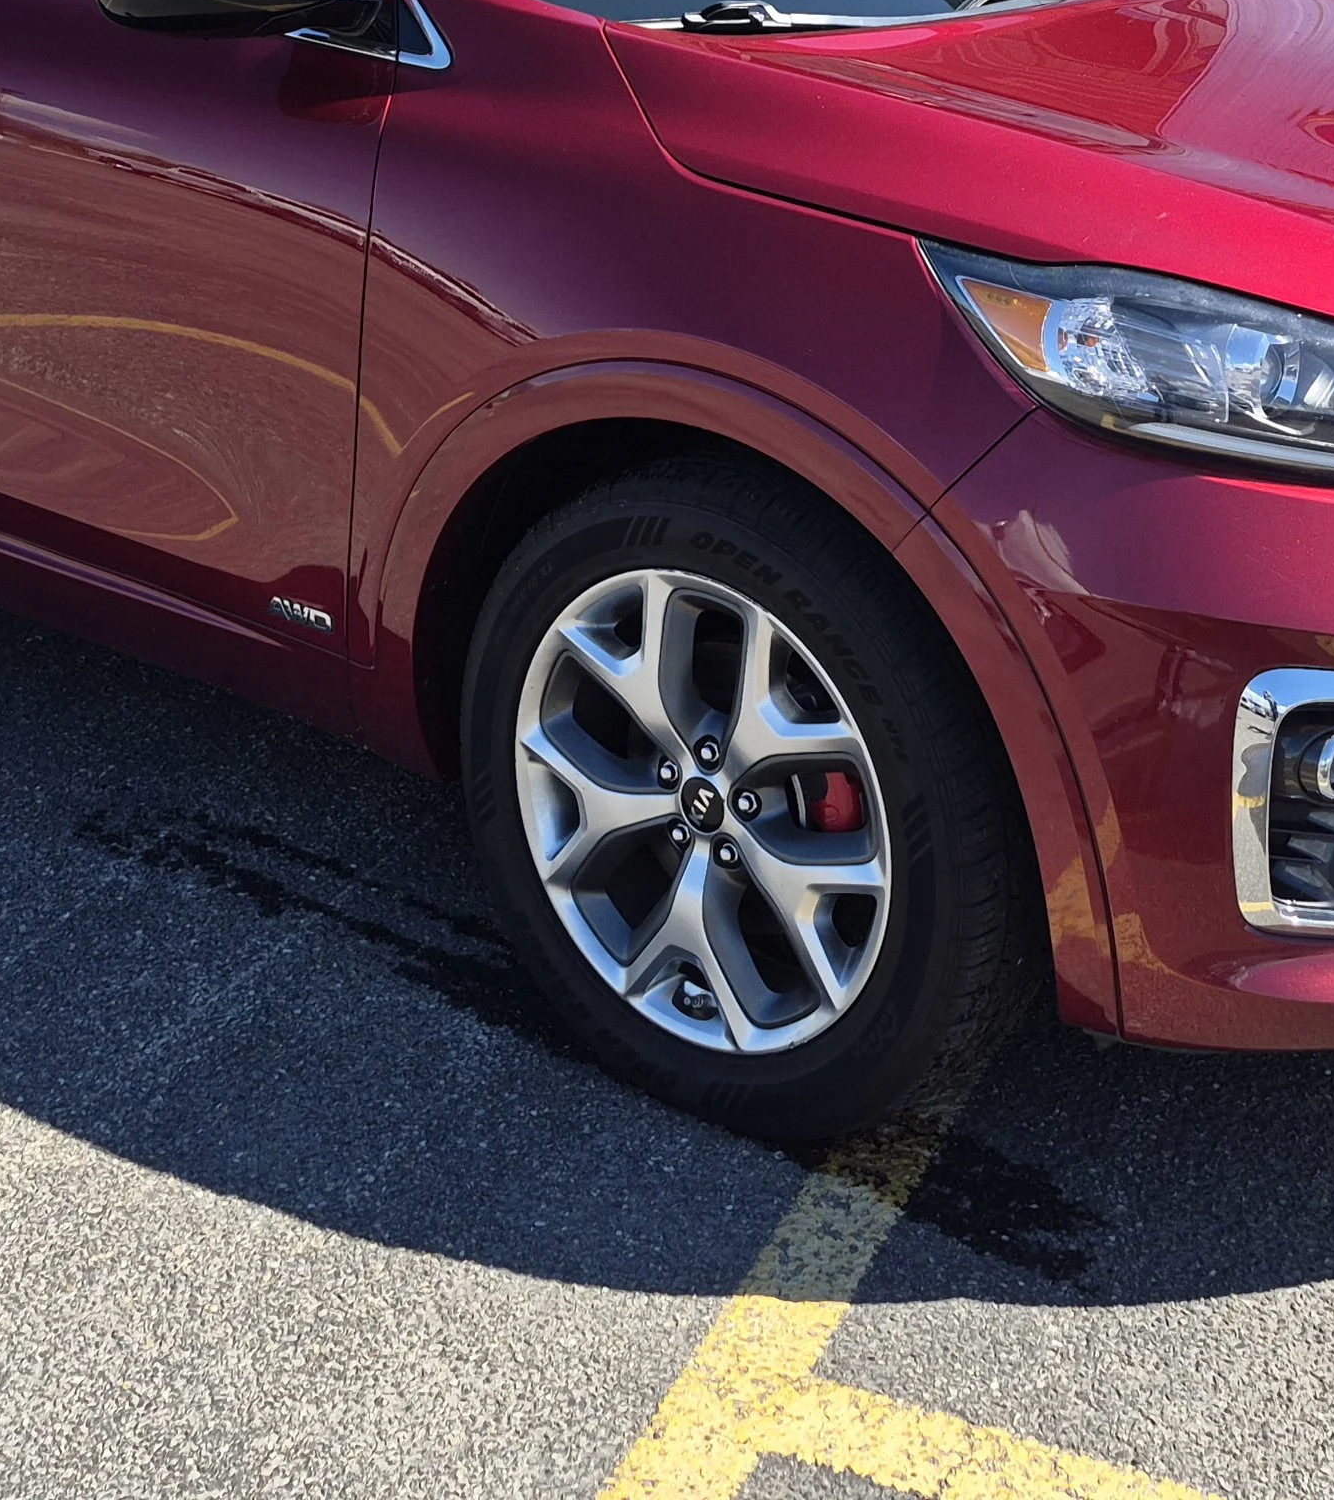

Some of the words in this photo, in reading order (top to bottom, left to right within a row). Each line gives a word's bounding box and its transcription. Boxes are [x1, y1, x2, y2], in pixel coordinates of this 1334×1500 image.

[269, 595, 333, 633] AWD
[688, 530, 784, 587] OPEN
[782, 588, 885, 705] RANGE
